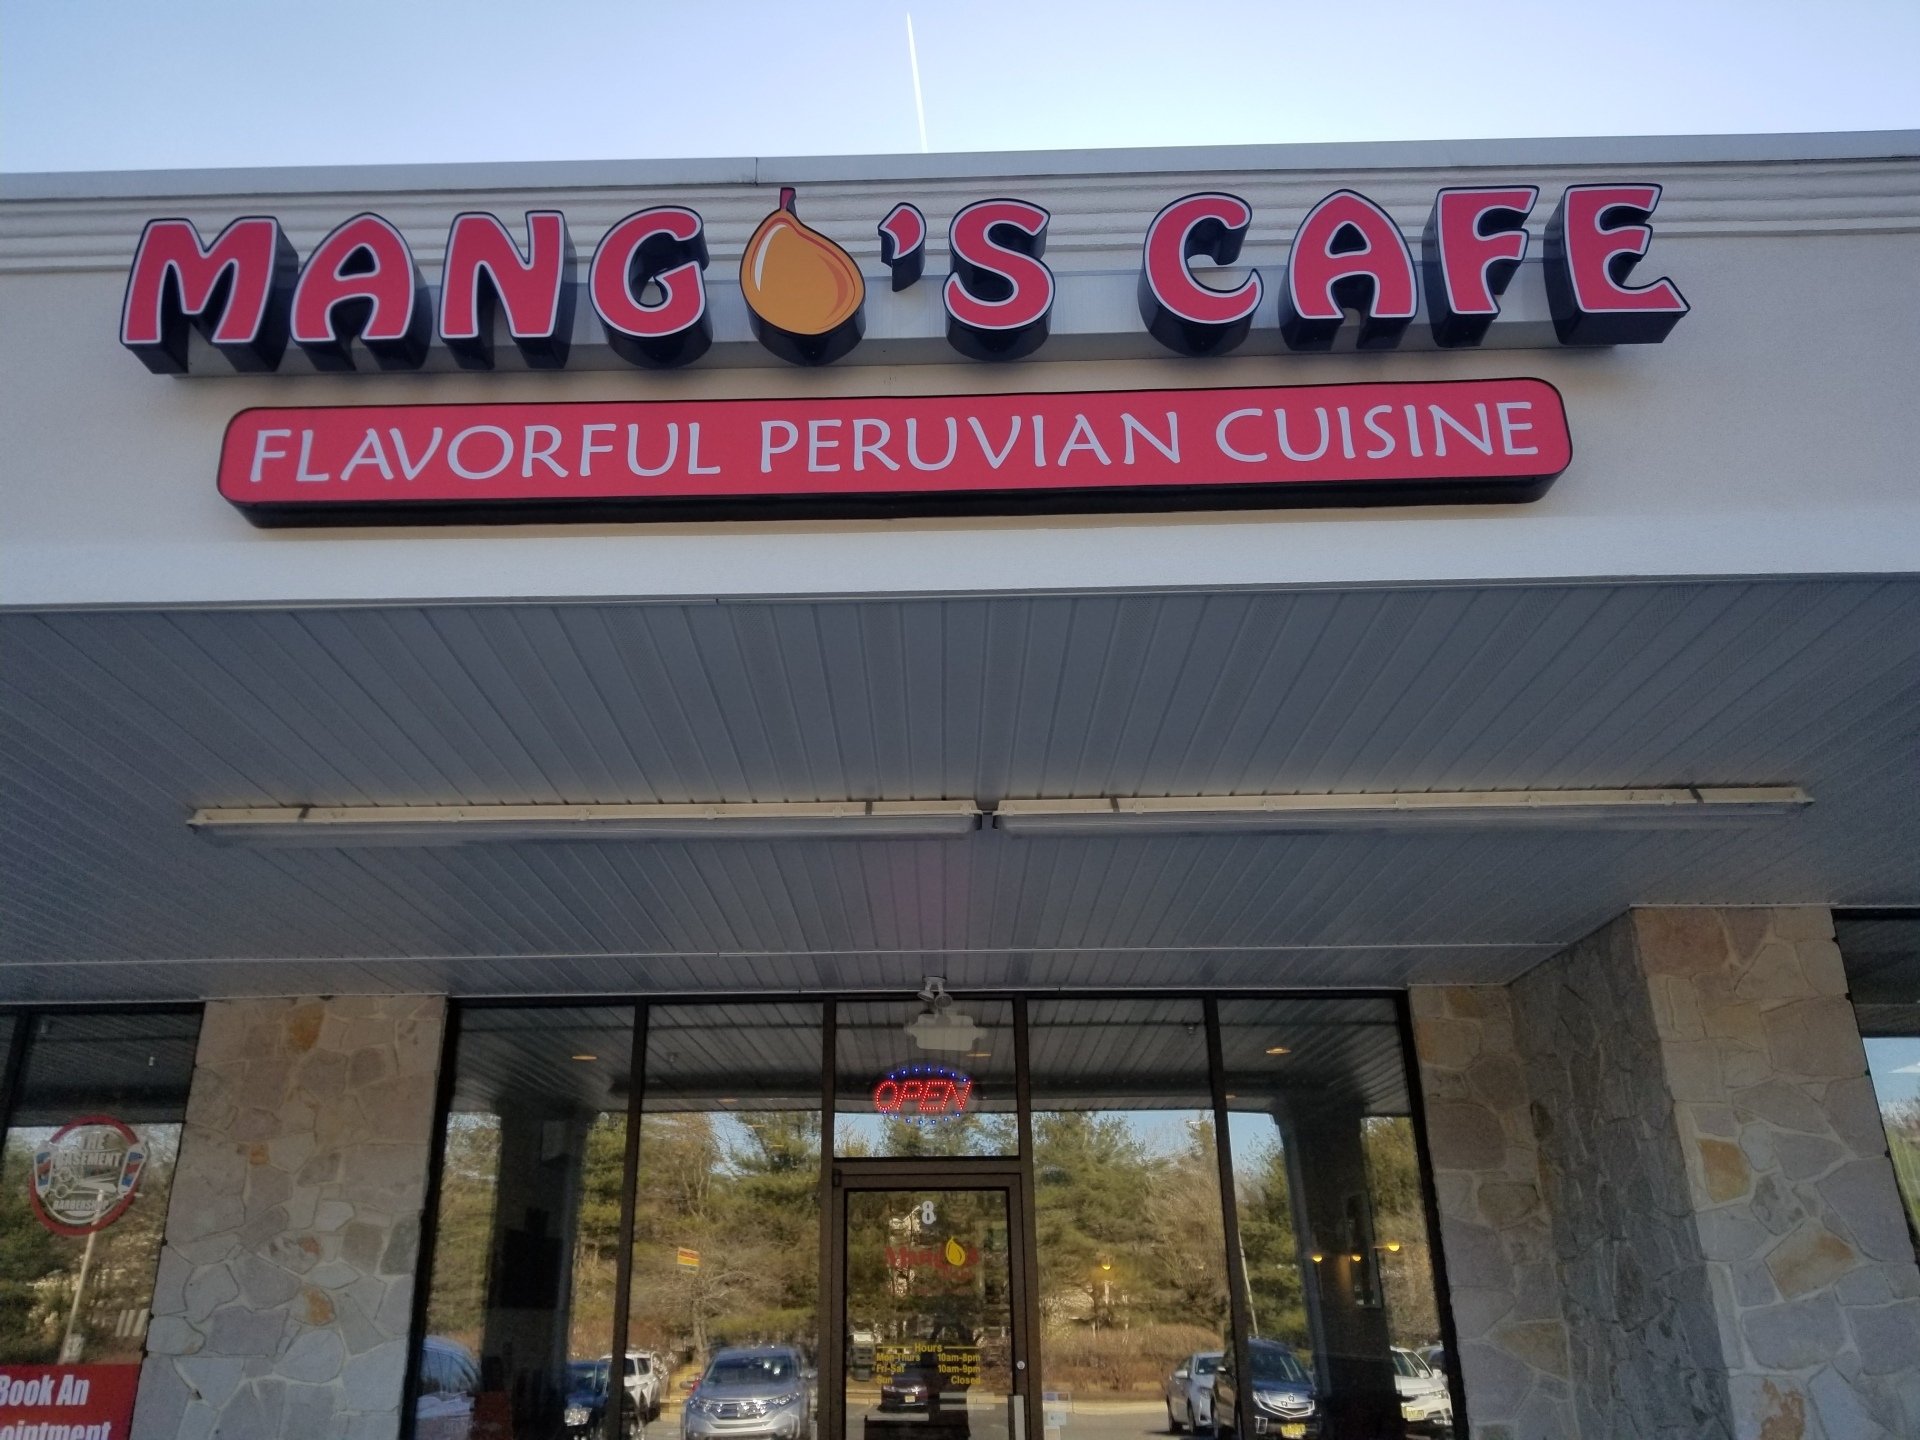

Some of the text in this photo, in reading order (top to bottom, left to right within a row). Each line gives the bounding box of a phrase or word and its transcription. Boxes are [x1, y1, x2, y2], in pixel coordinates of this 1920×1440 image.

[1142, 183, 1690, 326] CAFE
[249, 401, 1540, 484] FLAVORFUL PERUVIAN CUISINE
[874, 1079, 973, 1112] OPEN
[921, 1200, 936, 1225] 8
[876, 1353, 981, 1363] Mon-Thurs 10am-8pm
[914, 1343, 943, 1352] Hours
[876, 1364, 981, 1374] Fri-Sat 10am-9pm
[876, 1375, 981, 1385] Sun Closed
[0, 1374, 90, 1406] Book An
